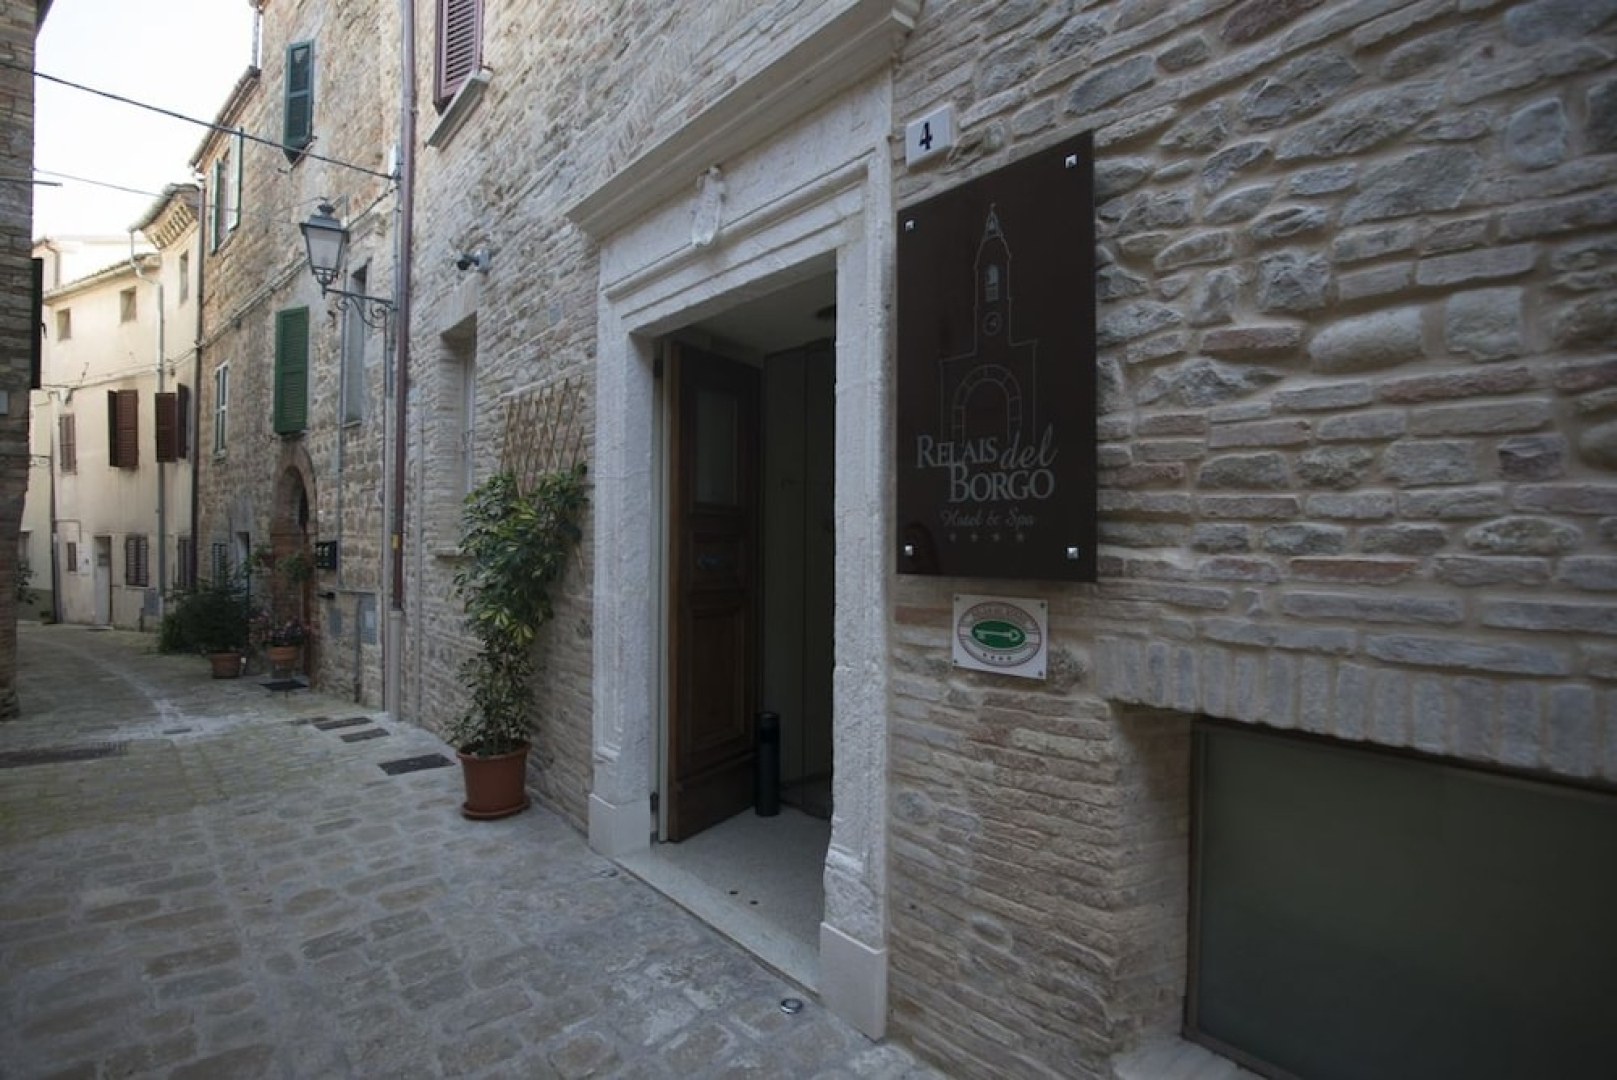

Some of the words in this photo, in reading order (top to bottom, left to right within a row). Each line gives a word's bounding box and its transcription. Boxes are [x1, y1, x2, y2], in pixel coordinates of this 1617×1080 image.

[918, 121, 933, 150] 4
[916, 434, 998, 468] RELAIS
[999, 423, 1059, 470] del
[948, 463, 1055, 503] BORGO
[941, 507, 983, 527] Hotel
[986, 510, 1000, 527] &
[1006, 505, 1035, 530] Spa
